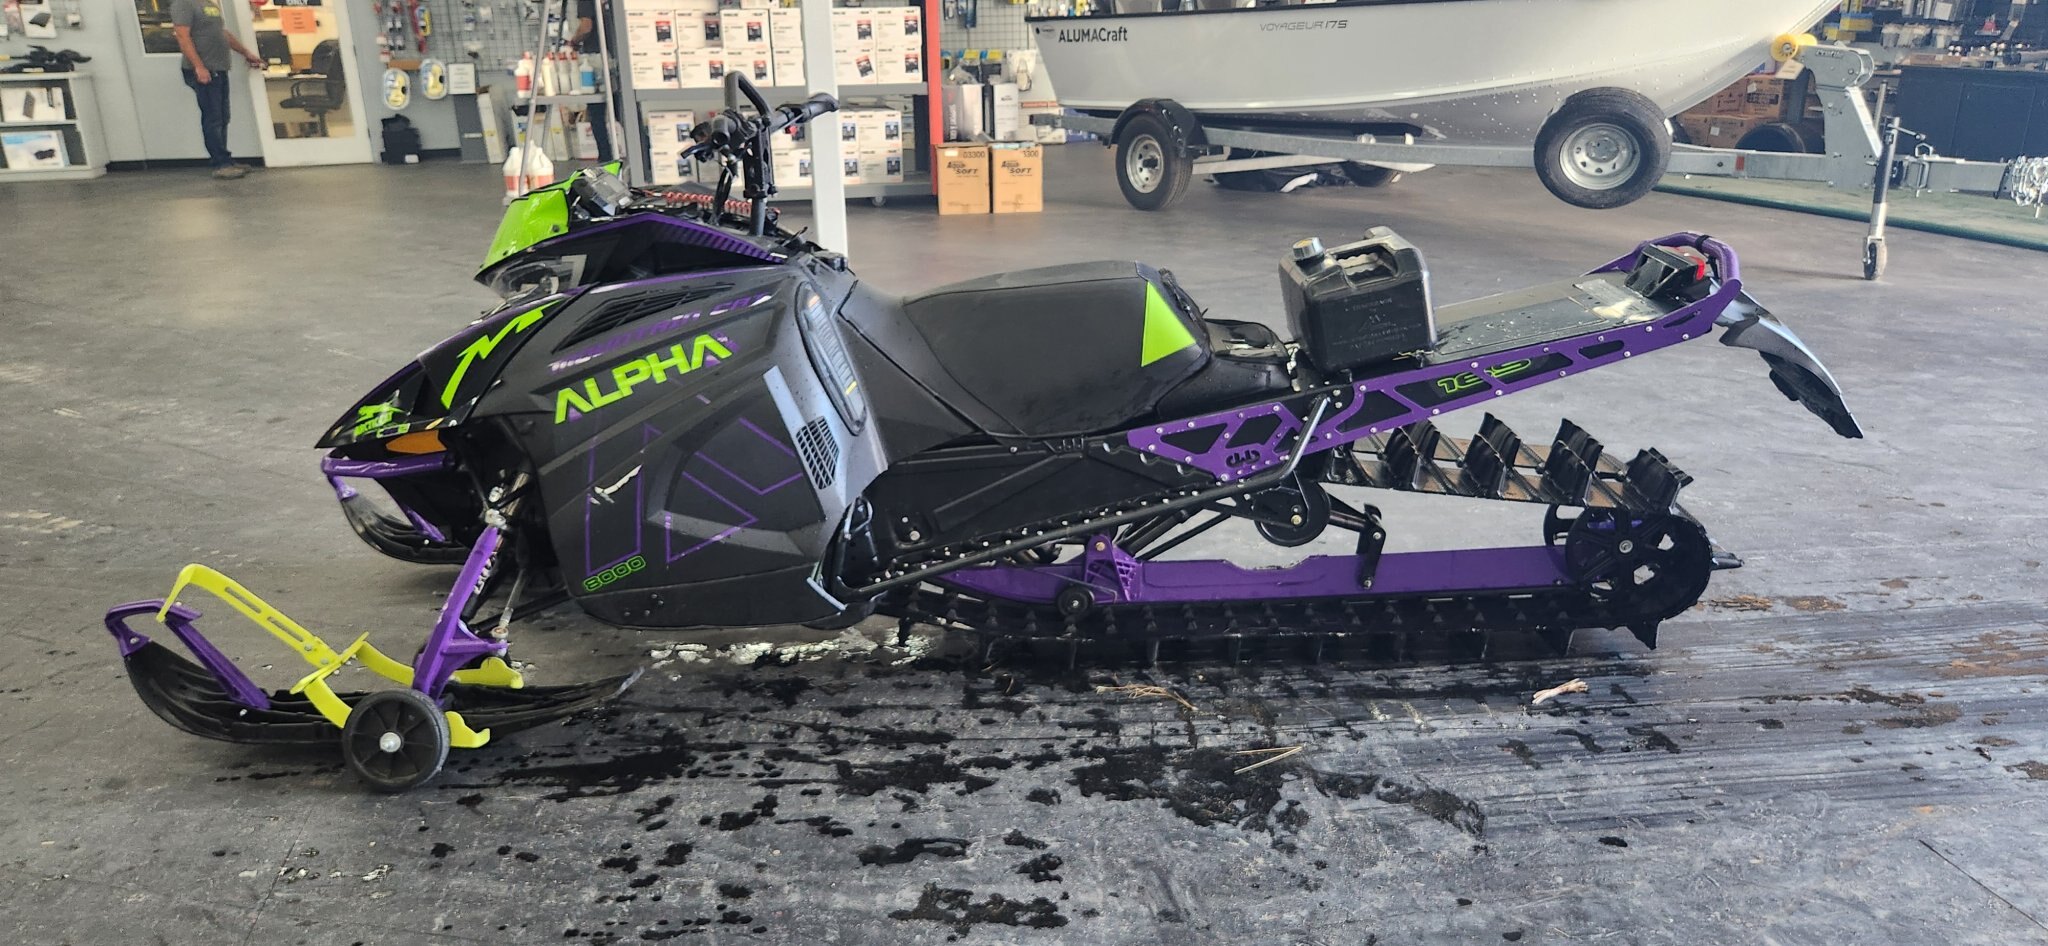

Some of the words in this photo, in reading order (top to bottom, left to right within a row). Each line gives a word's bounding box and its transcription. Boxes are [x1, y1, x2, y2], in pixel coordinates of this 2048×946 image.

[1058, 26, 1128, 42] ALUMACraft
[1259, 21, 1324, 31] VOYAGEUR
[554, 334, 733, 425] ALPHA
[583, 555, 646, 592] 8000
